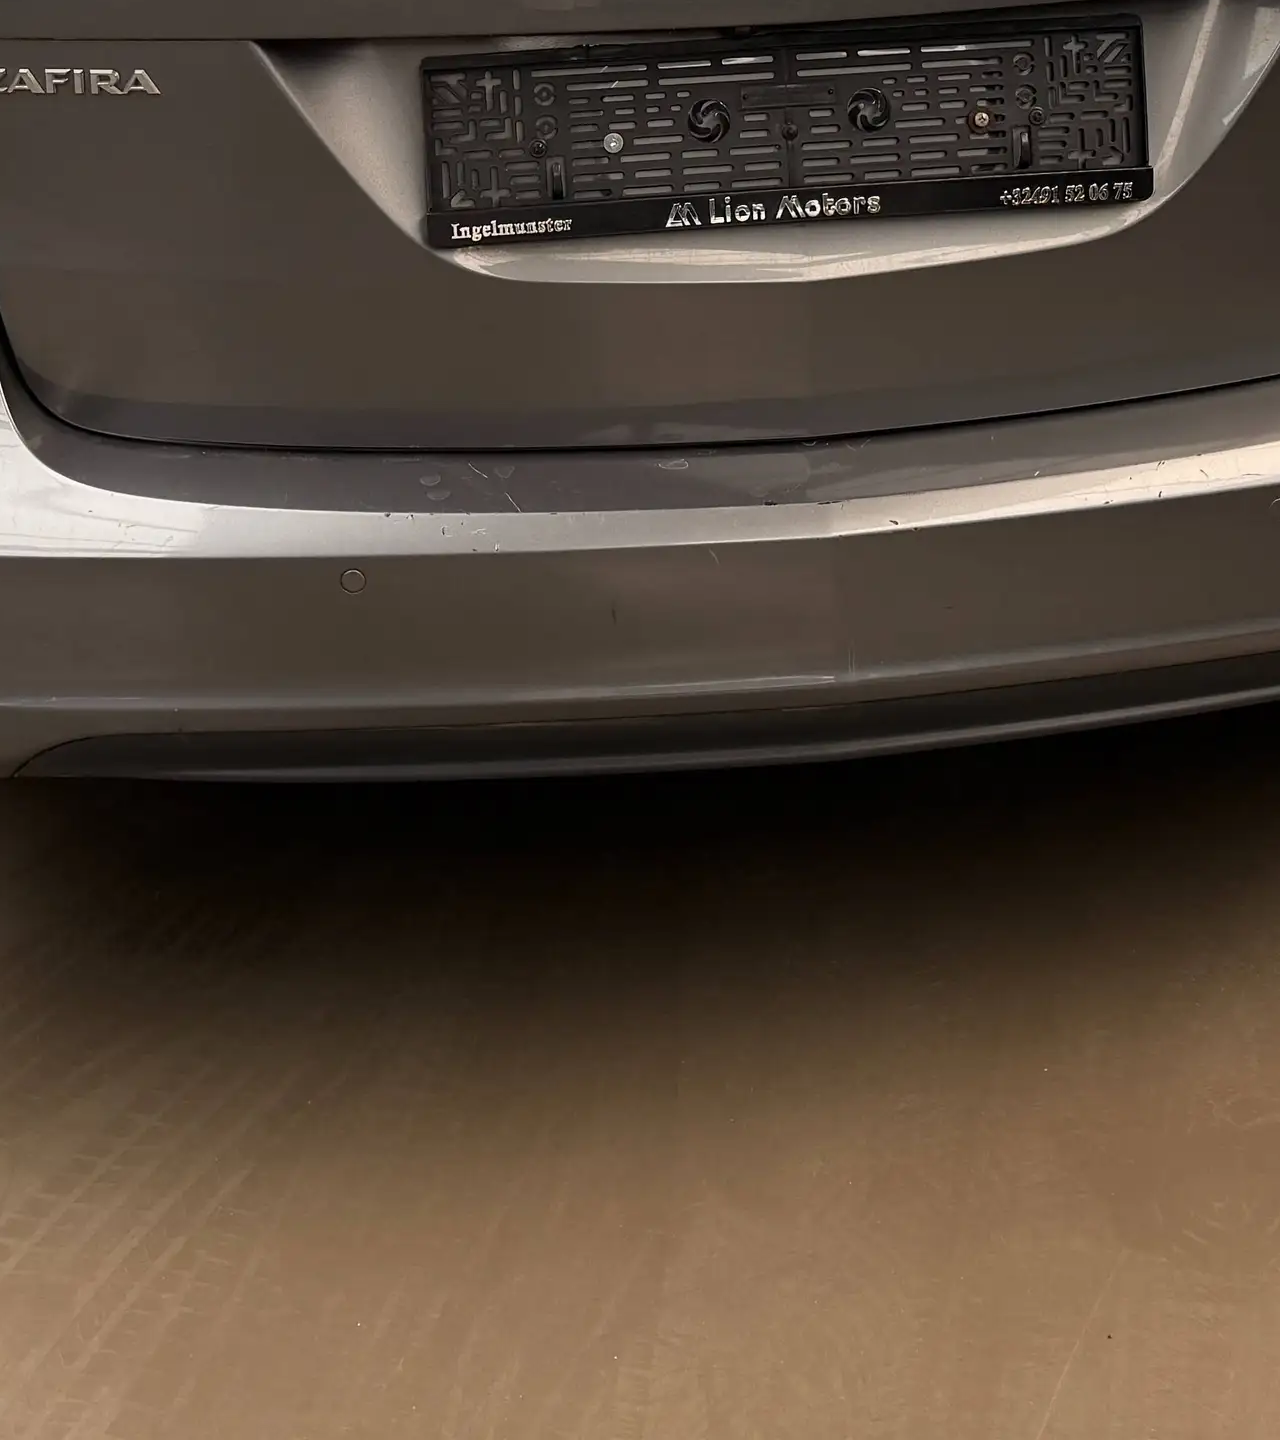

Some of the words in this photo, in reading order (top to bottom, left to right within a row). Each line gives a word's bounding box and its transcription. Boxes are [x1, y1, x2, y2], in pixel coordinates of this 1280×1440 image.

[999, 185, 1060, 206] +32491
[1064, 183, 1086, 203] 52
[1088, 182, 1109, 201] 06
[1113, 181, 1134, 200] 75
[708, 195, 766, 224] Lion
[775, 192, 882, 220] Motors
[450, 218, 573, 242] Ingelmunster
